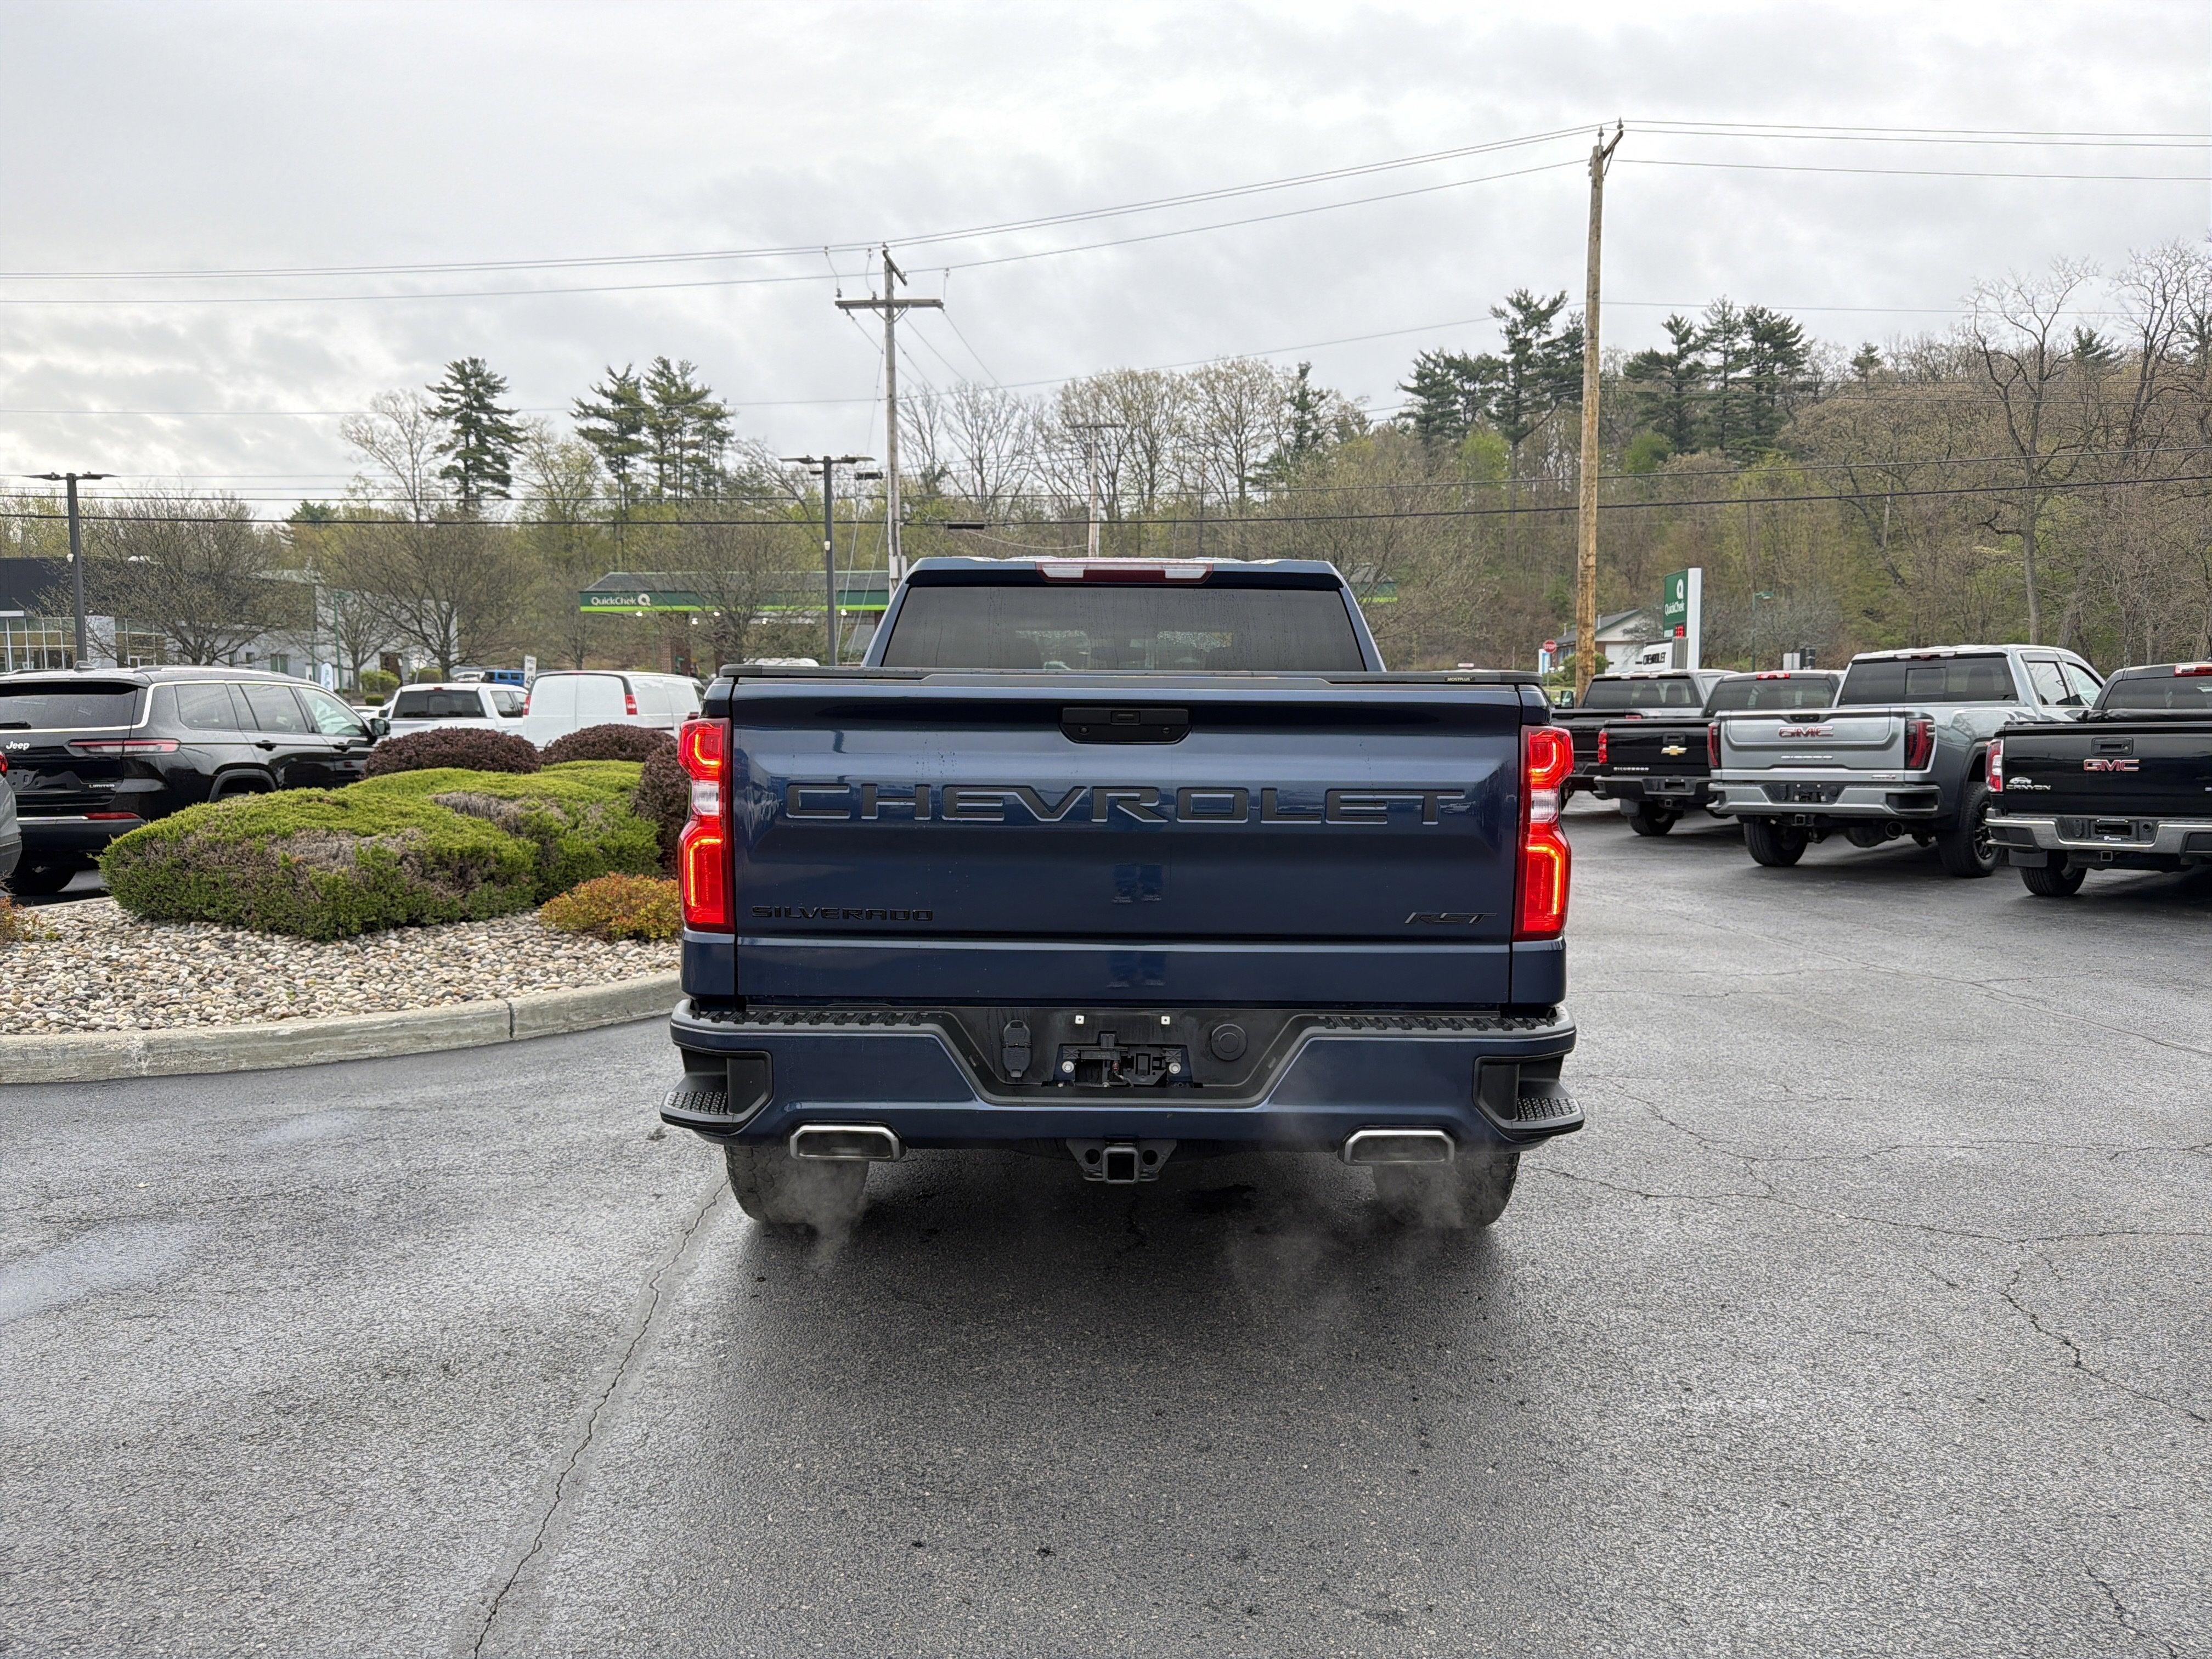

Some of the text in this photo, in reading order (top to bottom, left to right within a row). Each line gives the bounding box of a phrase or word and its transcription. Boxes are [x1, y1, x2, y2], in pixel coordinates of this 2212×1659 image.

[591, 596, 636, 605] QuickChek
[1664, 600, 1685, 616] QuickChek
[1779, 726, 1833, 737] GMC
[5, 741, 30, 751] Jeep
[2084, 759, 2140, 771] GMC
[786, 783, 1465, 825] CHEVROLET
[752, 905, 933, 921] SILVERADO
[1404, 912, 1497, 924] RST
